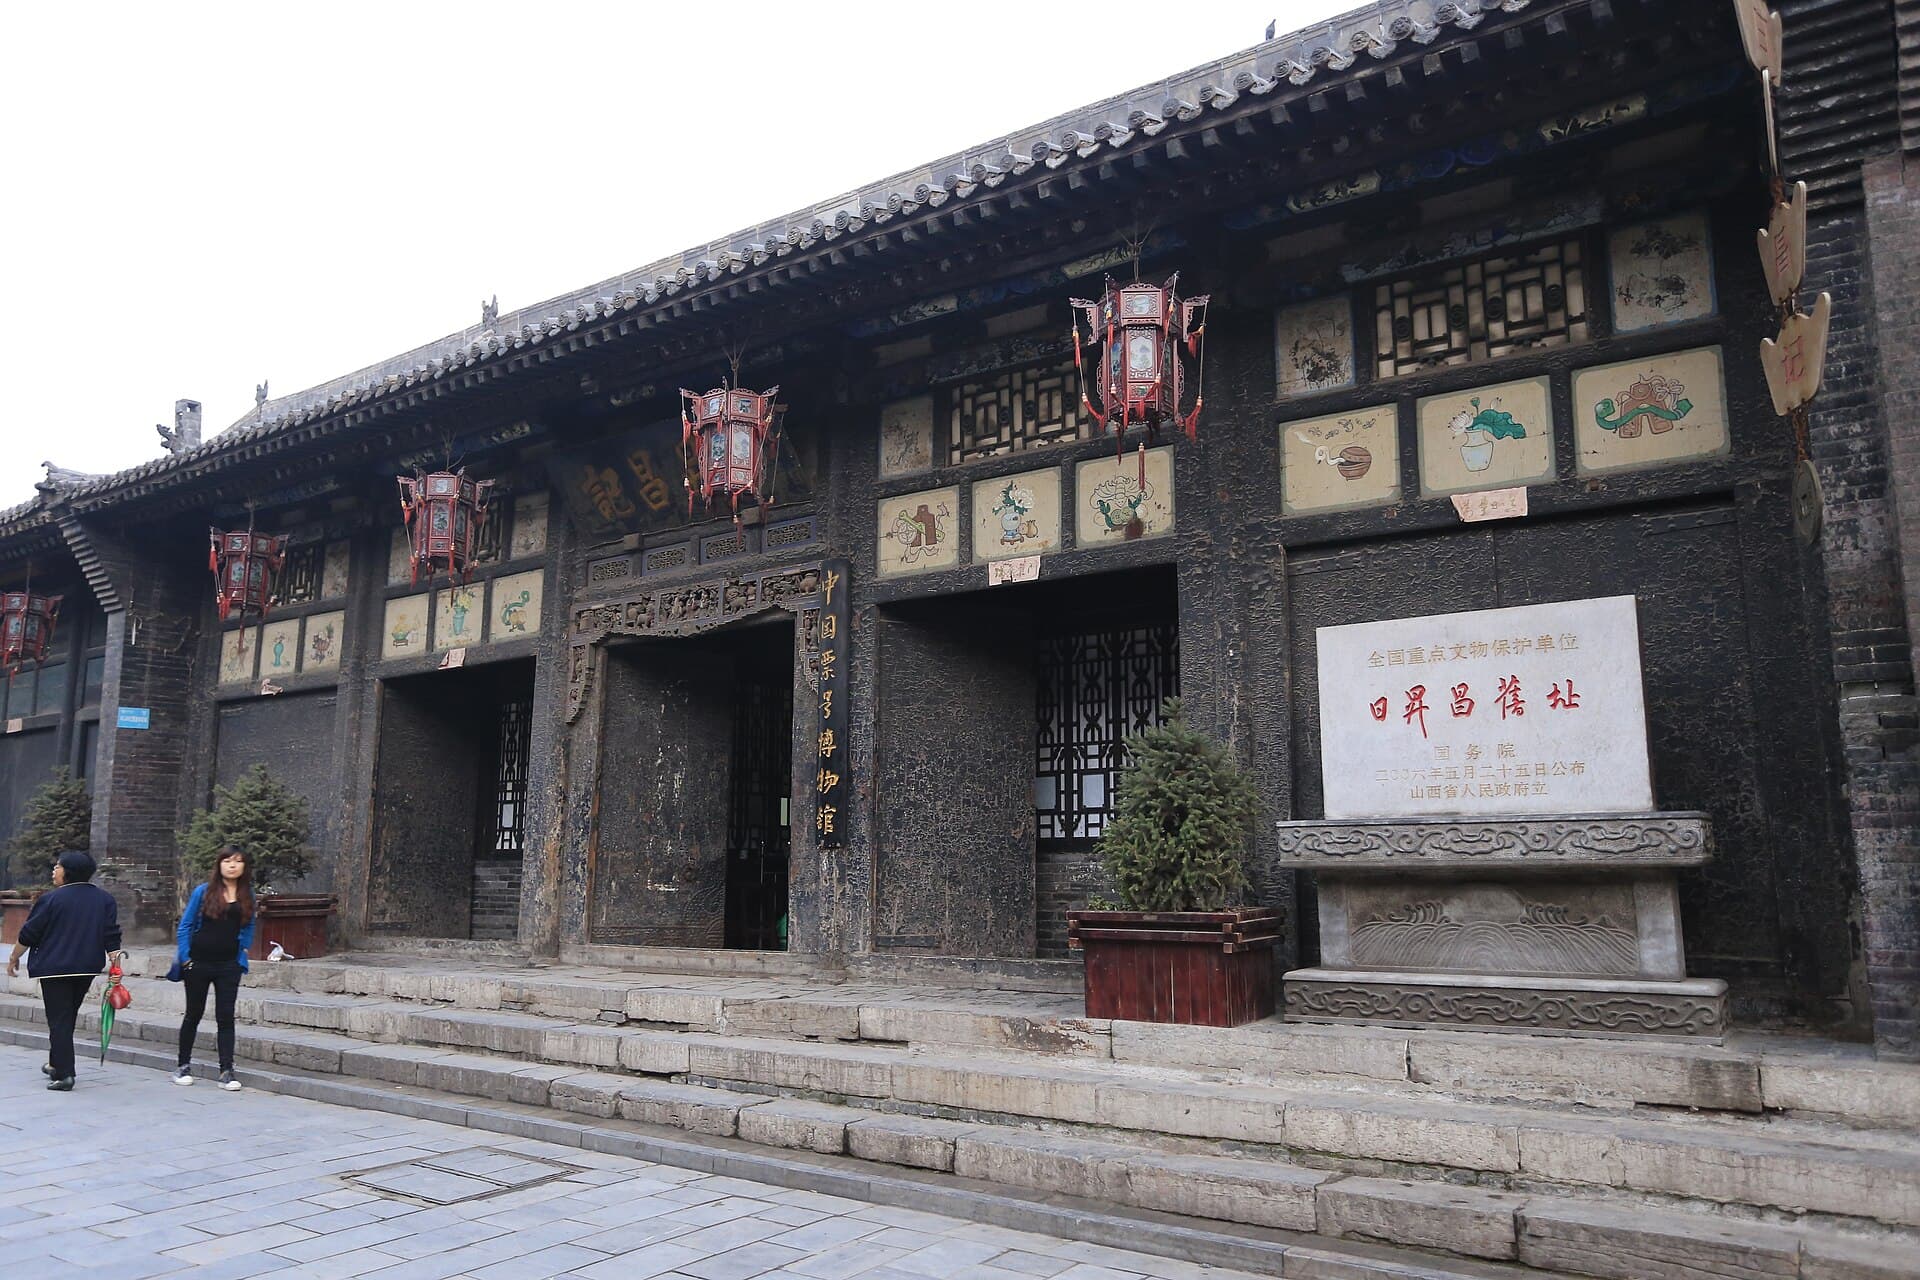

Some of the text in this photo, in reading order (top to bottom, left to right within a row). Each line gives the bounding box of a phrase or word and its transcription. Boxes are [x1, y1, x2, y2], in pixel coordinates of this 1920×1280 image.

[1367, 632, 1580, 668] 全国重点文物保护单位
[1434, 743, 1516, 761] 国务院
[1410, 781, 1549, 800] 山西省人民政府立
